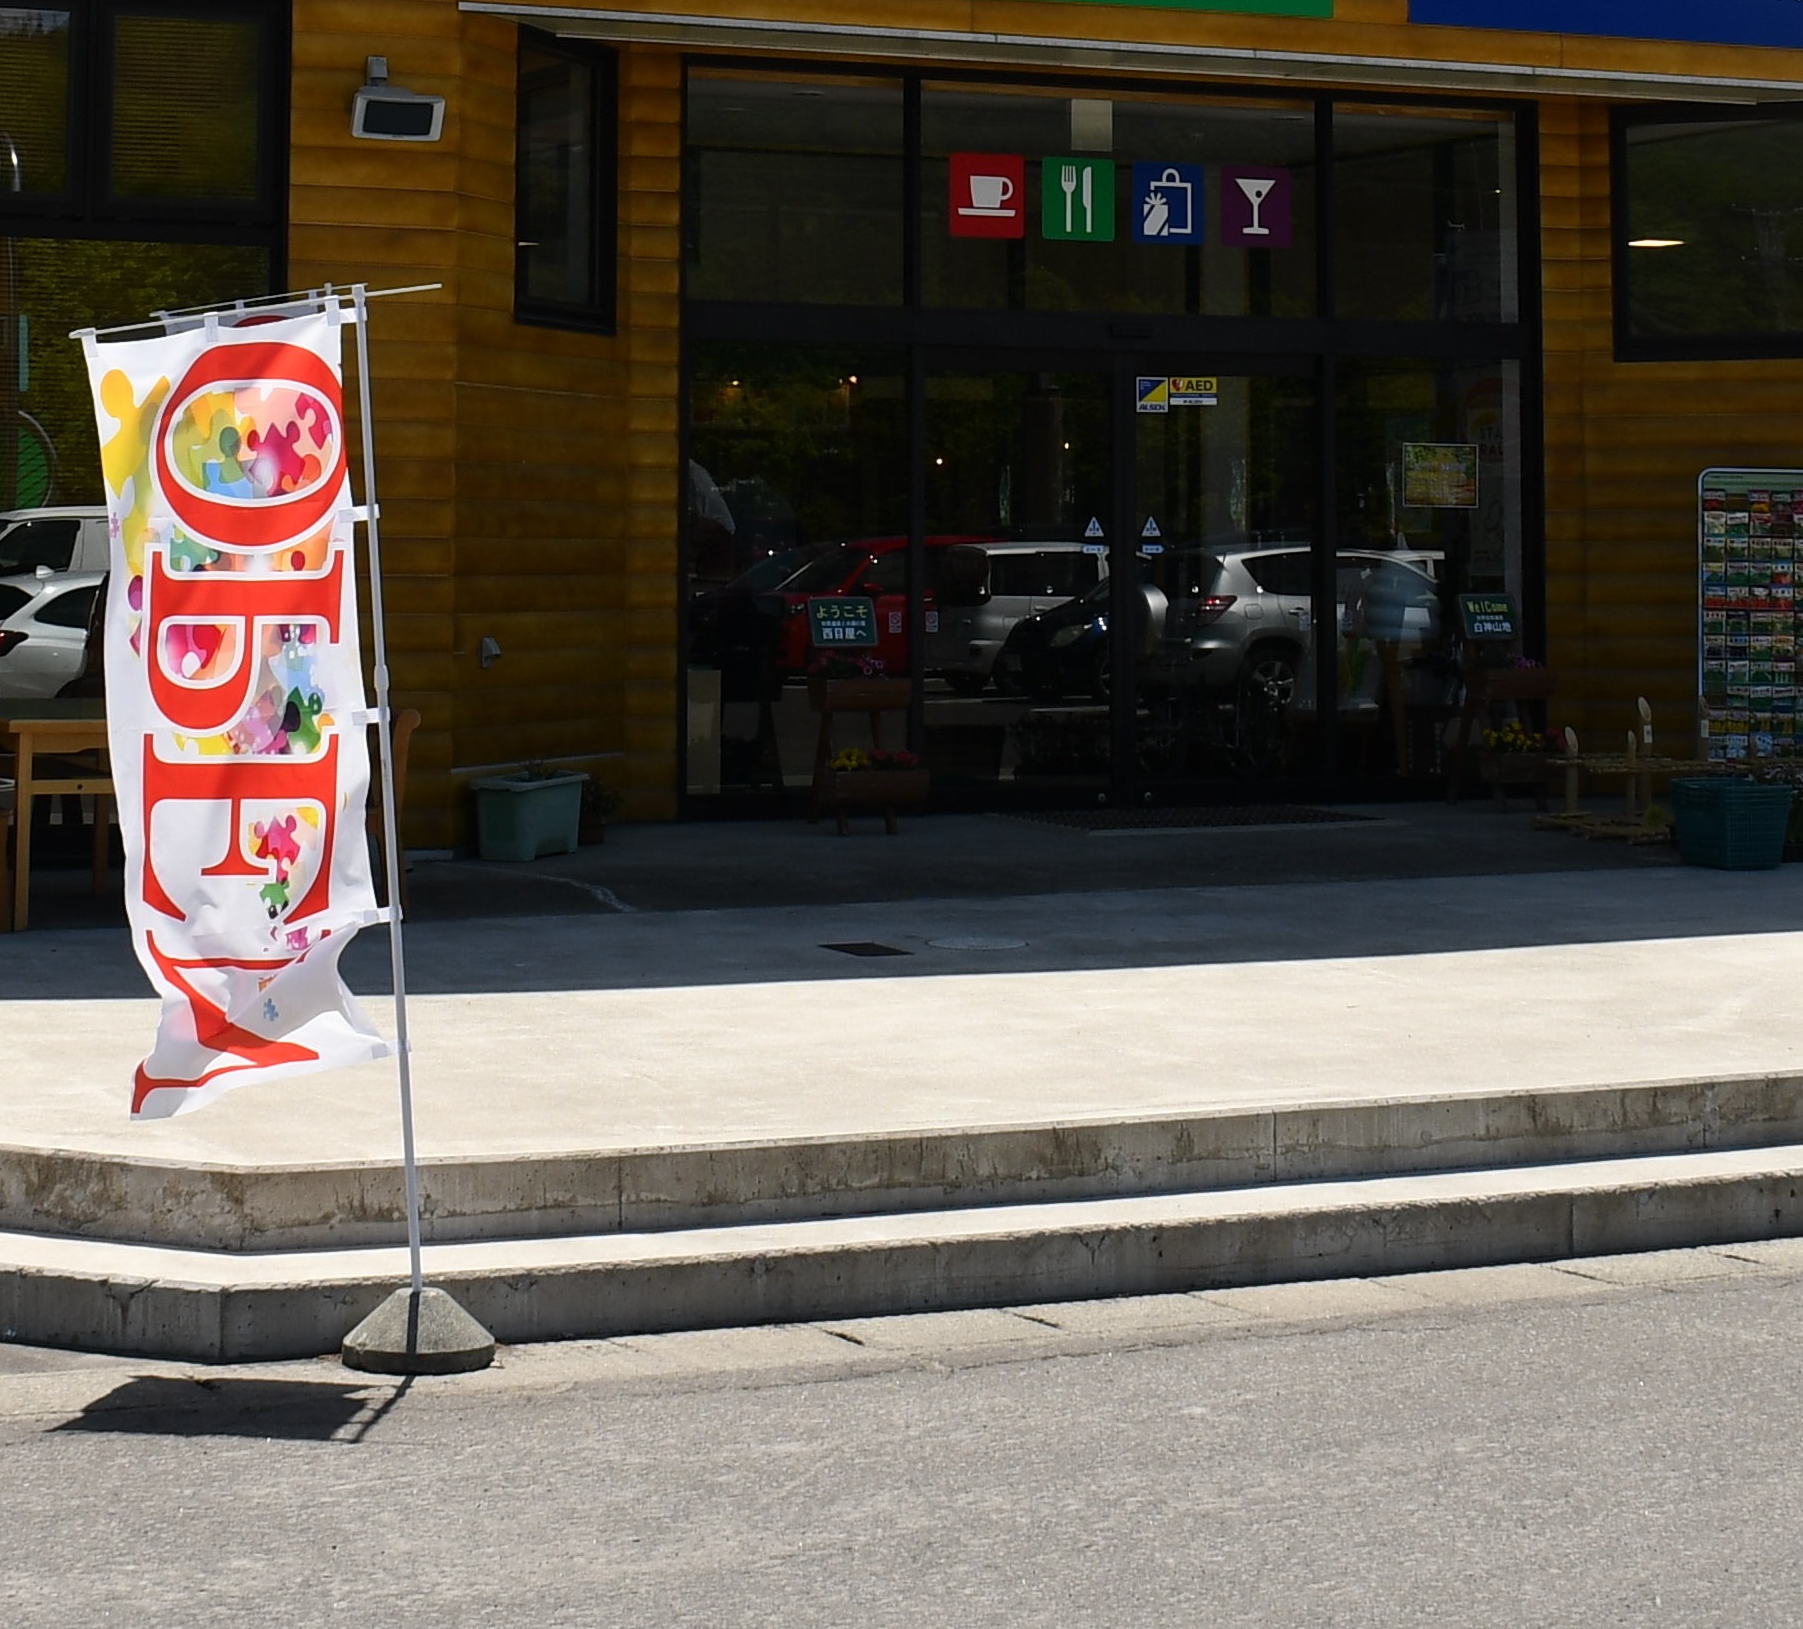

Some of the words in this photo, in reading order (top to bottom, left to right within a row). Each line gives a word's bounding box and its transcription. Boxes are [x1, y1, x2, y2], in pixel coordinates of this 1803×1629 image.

[1185, 379, 1214, 391] AED
[816, 604, 868, 619] ようこそ
